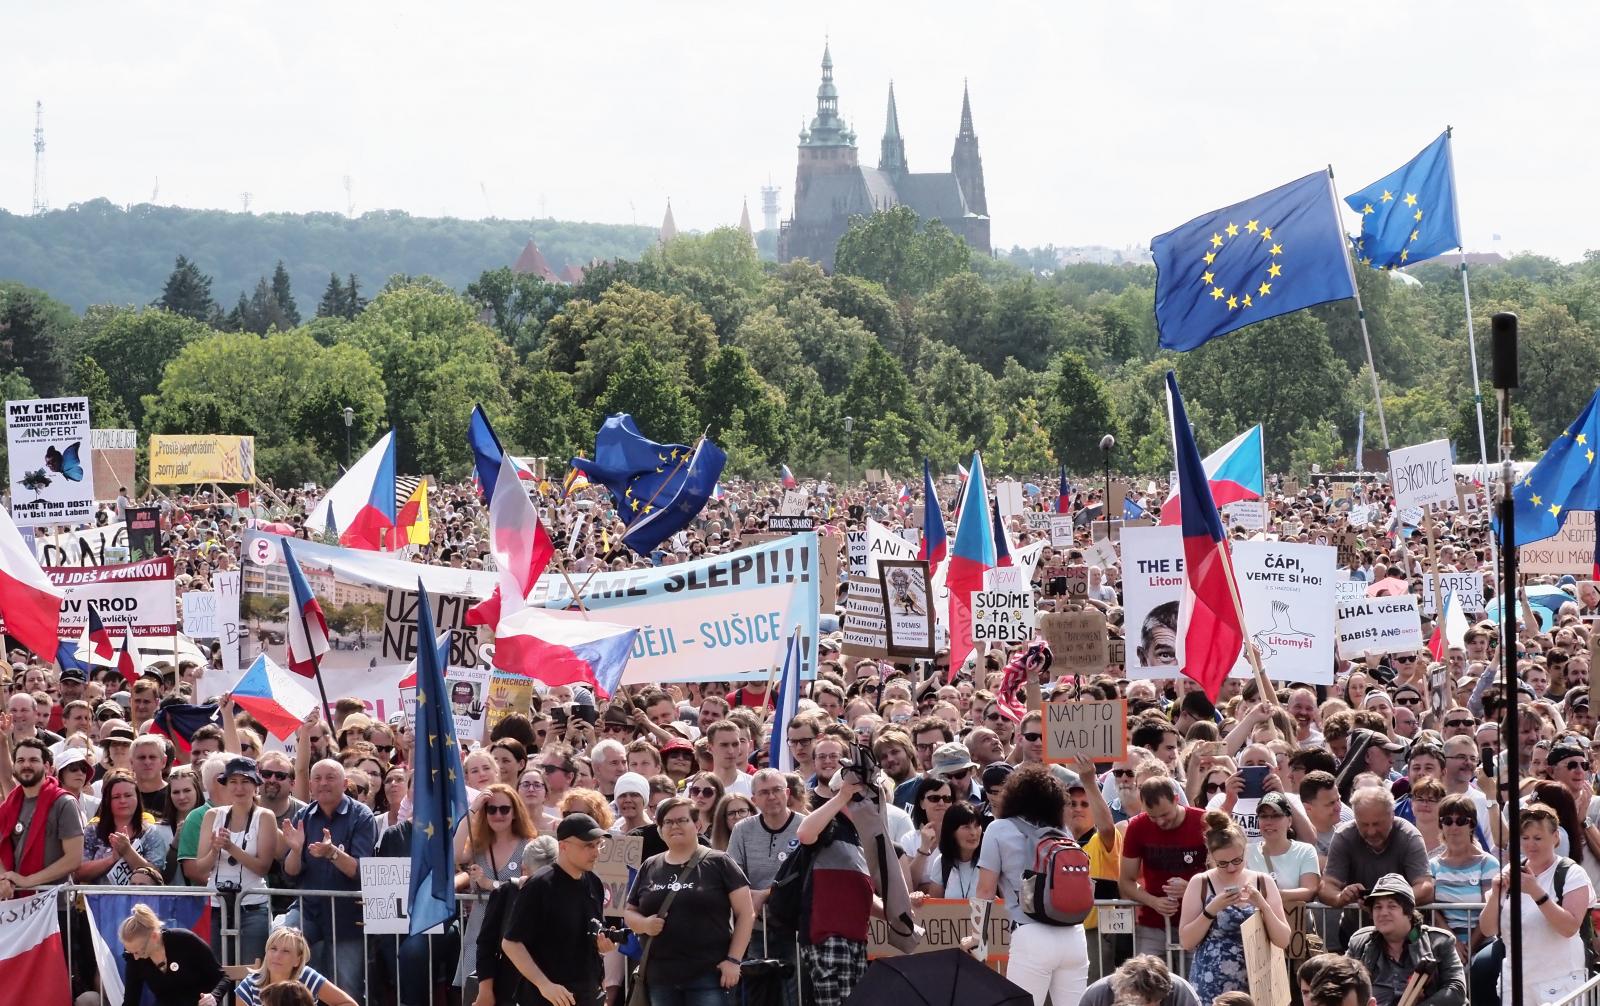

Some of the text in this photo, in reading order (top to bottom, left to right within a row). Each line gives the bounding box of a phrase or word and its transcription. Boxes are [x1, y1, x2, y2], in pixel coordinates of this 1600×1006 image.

[10, 402, 86, 416] MY CHCEME
[15, 415, 43, 423] ZNOVU
[20, 426, 77, 438] ANOFERT
[42, 502, 65, 510] TOHO
[67, 500, 93, 508] DOST!
[49, 509, 63, 518] nad
[65, 508, 90, 516] Labem
[870, 538, 901, 557] ANI
[1264, 553, 1305, 574] ČÁPI,
[1523, 549, 1554, 564] DOKSY
[1557, 550, 1564, 564] U
[65, 570, 98, 584] JDEŠ
[98, 571, 111, 580] K
[110, 563, 168, 579] TURKOVI
[1137, 559, 1170, 574] THE
[1149, 576, 1183, 587] Litom
[1246, 572, 1322, 586] VEMTE SI HO!
[849, 582, 881, 594] Manon
[847, 600, 879, 613] Manon
[1337, 602, 1415, 620] LHAL VČERA
[846, 615, 878, 628] Manon
[149, 626, 172, 635] (KHB)
[631, 624, 677, 660] DĚJI
[699, 611, 781, 649] SUŠICE
[975, 622, 1033, 642] BABIŠI
[1268, 636, 1313, 649] Litomyšl
[1088, 703, 1113, 721] TO
[920, 918, 972, 945] AGENT
